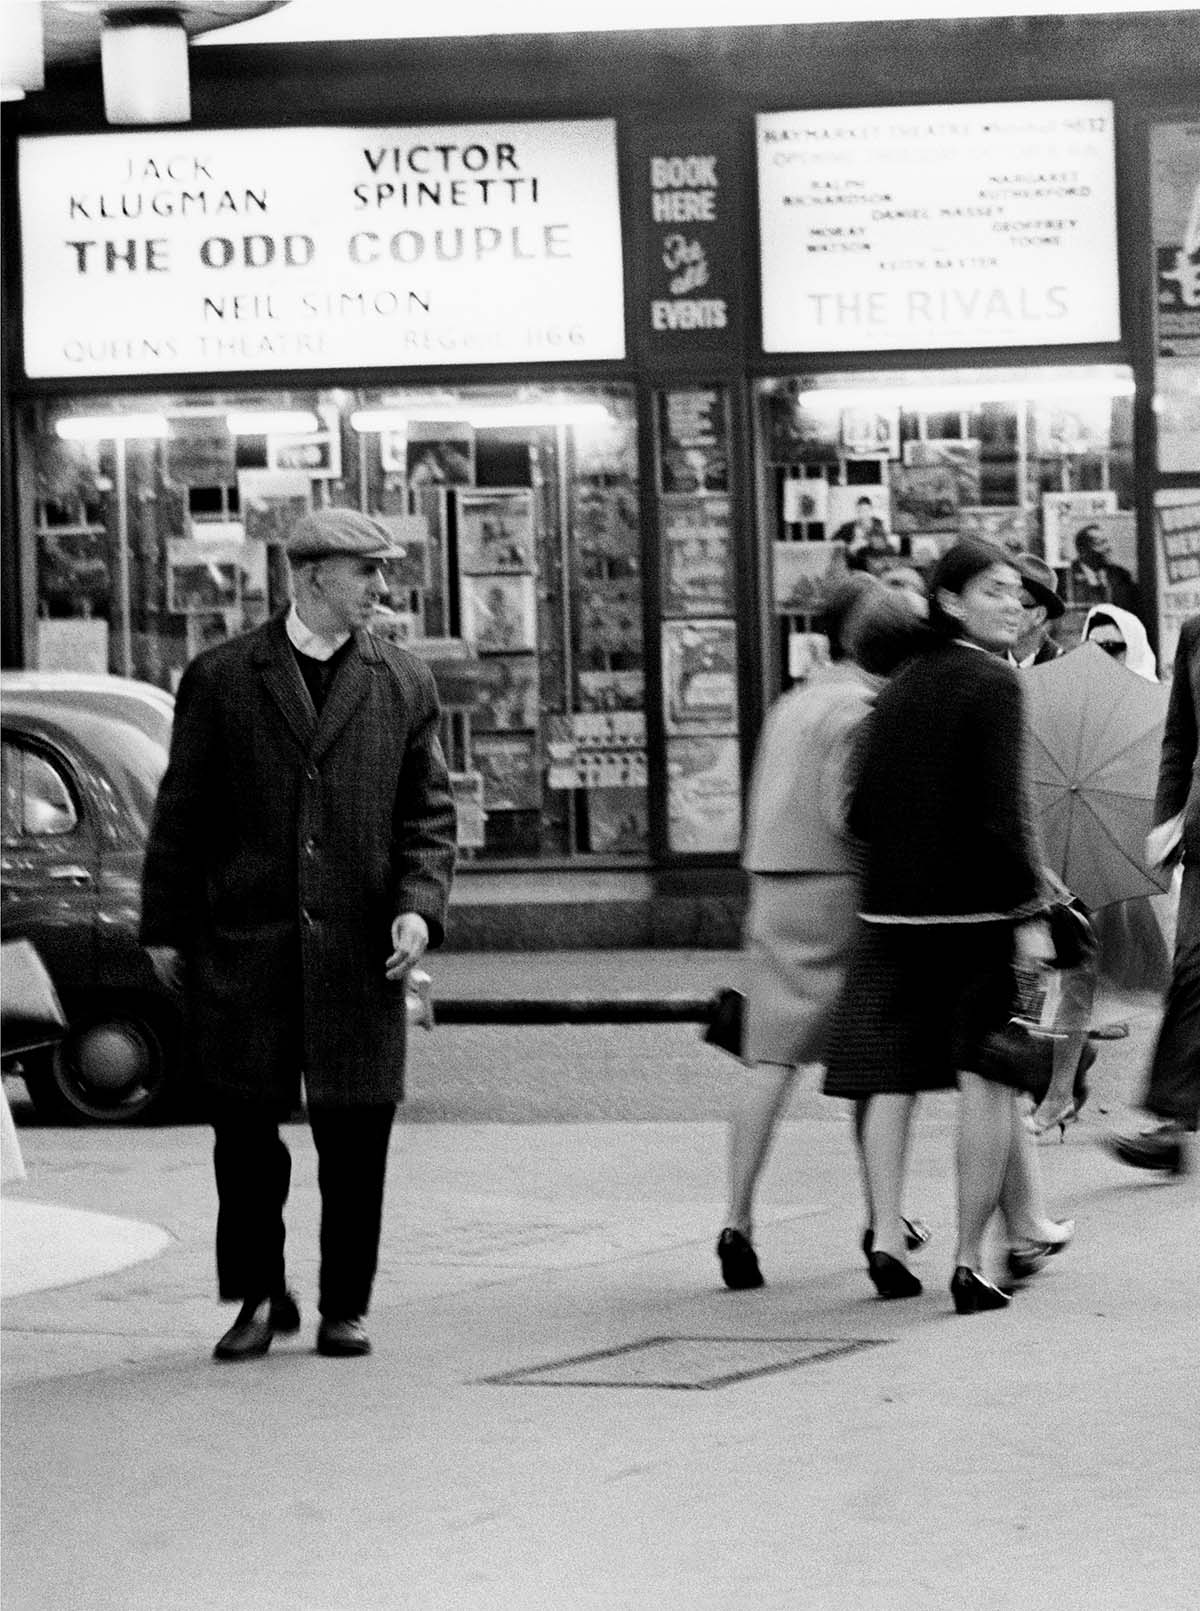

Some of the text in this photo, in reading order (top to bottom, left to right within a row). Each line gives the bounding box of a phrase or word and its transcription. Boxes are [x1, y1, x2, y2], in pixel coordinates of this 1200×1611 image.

[122, 155, 215, 183] JACK
[362, 143, 521, 175] VICTOR
[652, 156, 718, 189] BOOK
[68, 188, 270, 220] KLUGMAN
[353, 177, 540, 208] SPINETTI
[652, 190, 717, 222] HERE
[66, 223, 573, 275] THE ODD COUPLE
[202, 289, 432, 321] NEIL SIMON
[652, 299, 728, 330] EVENTS
[807, 286, 1069, 326] THE RIVALS
[62, 336, 178, 363] QUEENS
